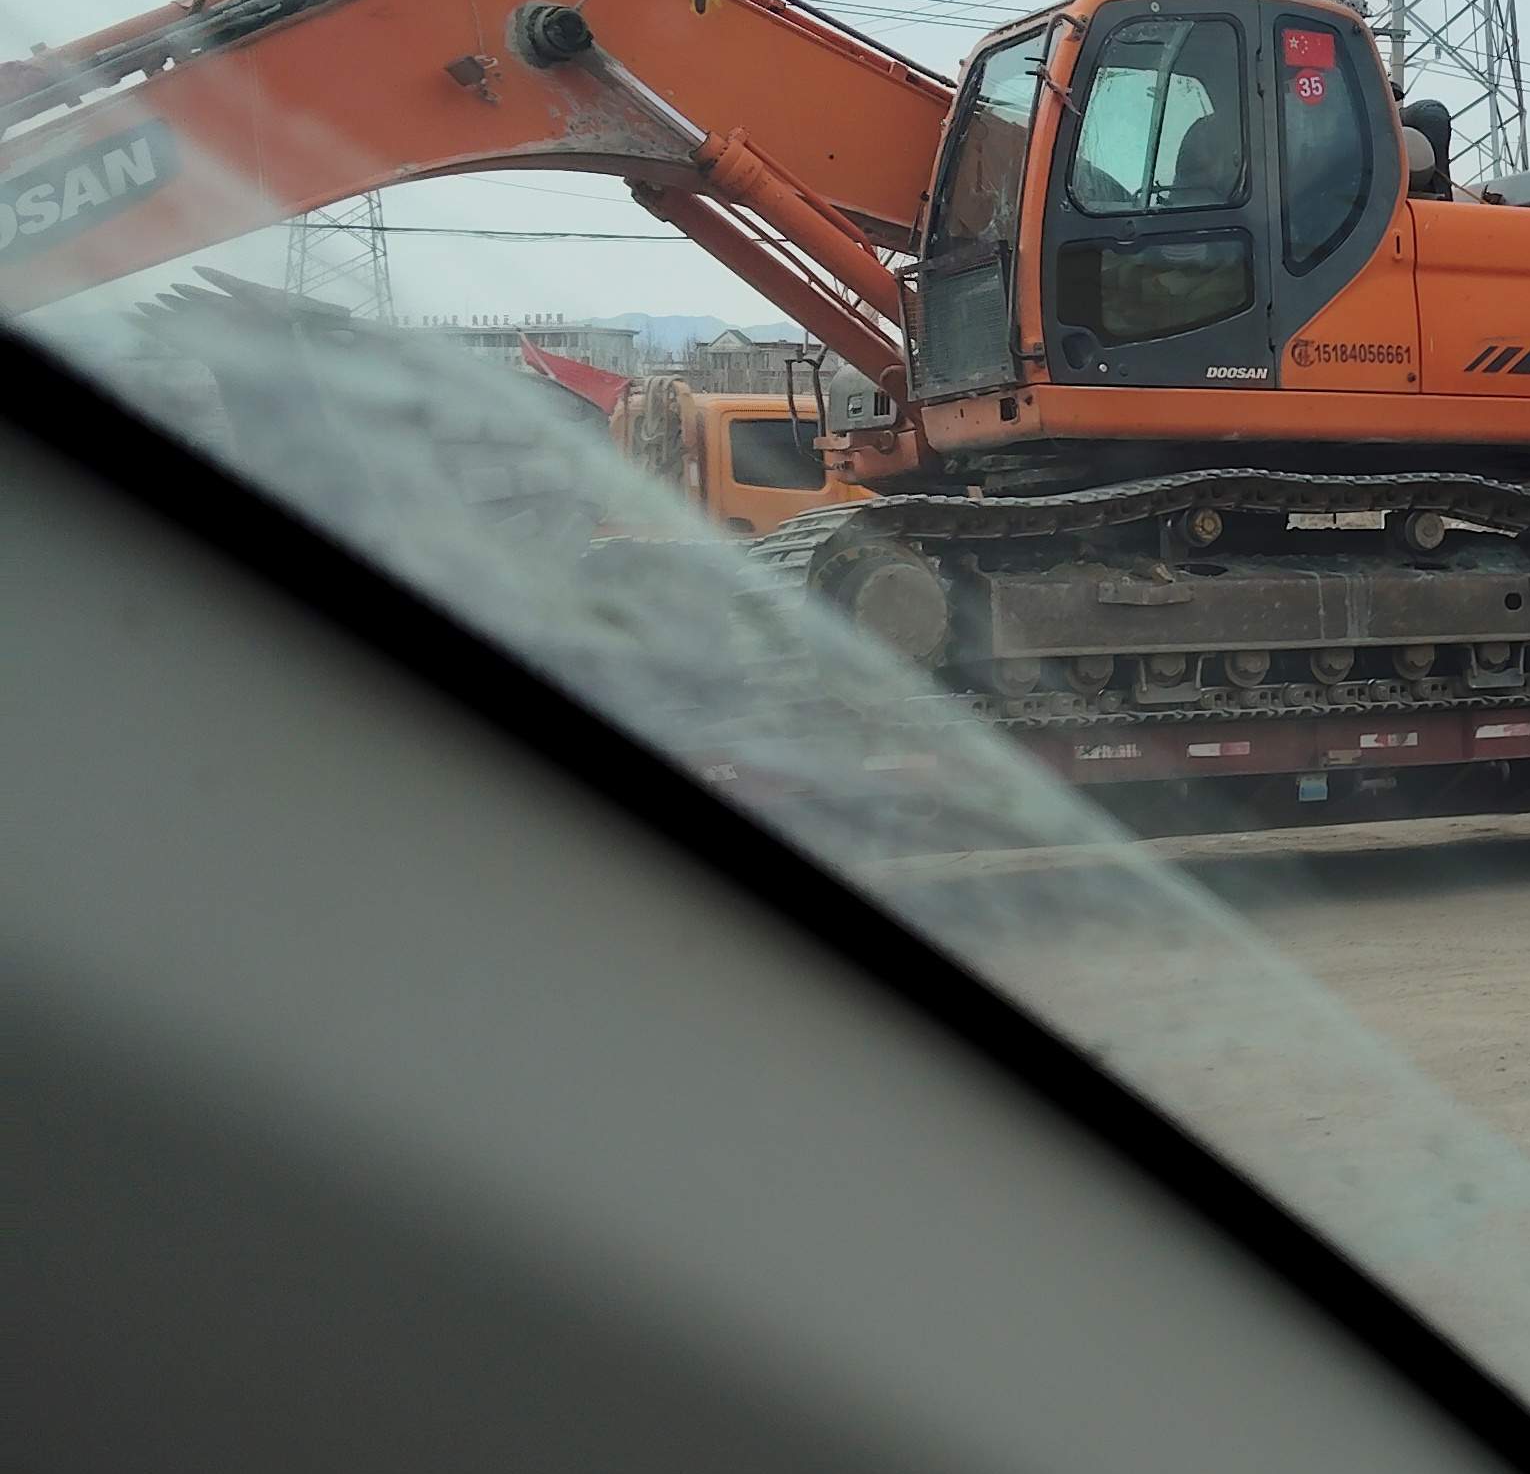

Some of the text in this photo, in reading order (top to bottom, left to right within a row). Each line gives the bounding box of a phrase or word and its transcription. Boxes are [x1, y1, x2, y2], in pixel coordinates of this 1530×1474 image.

[1299, 76, 1323, 97] 35
[1314, 343, 1412, 365] 15184056661
[1206, 366, 1268, 380] DOOSAN
